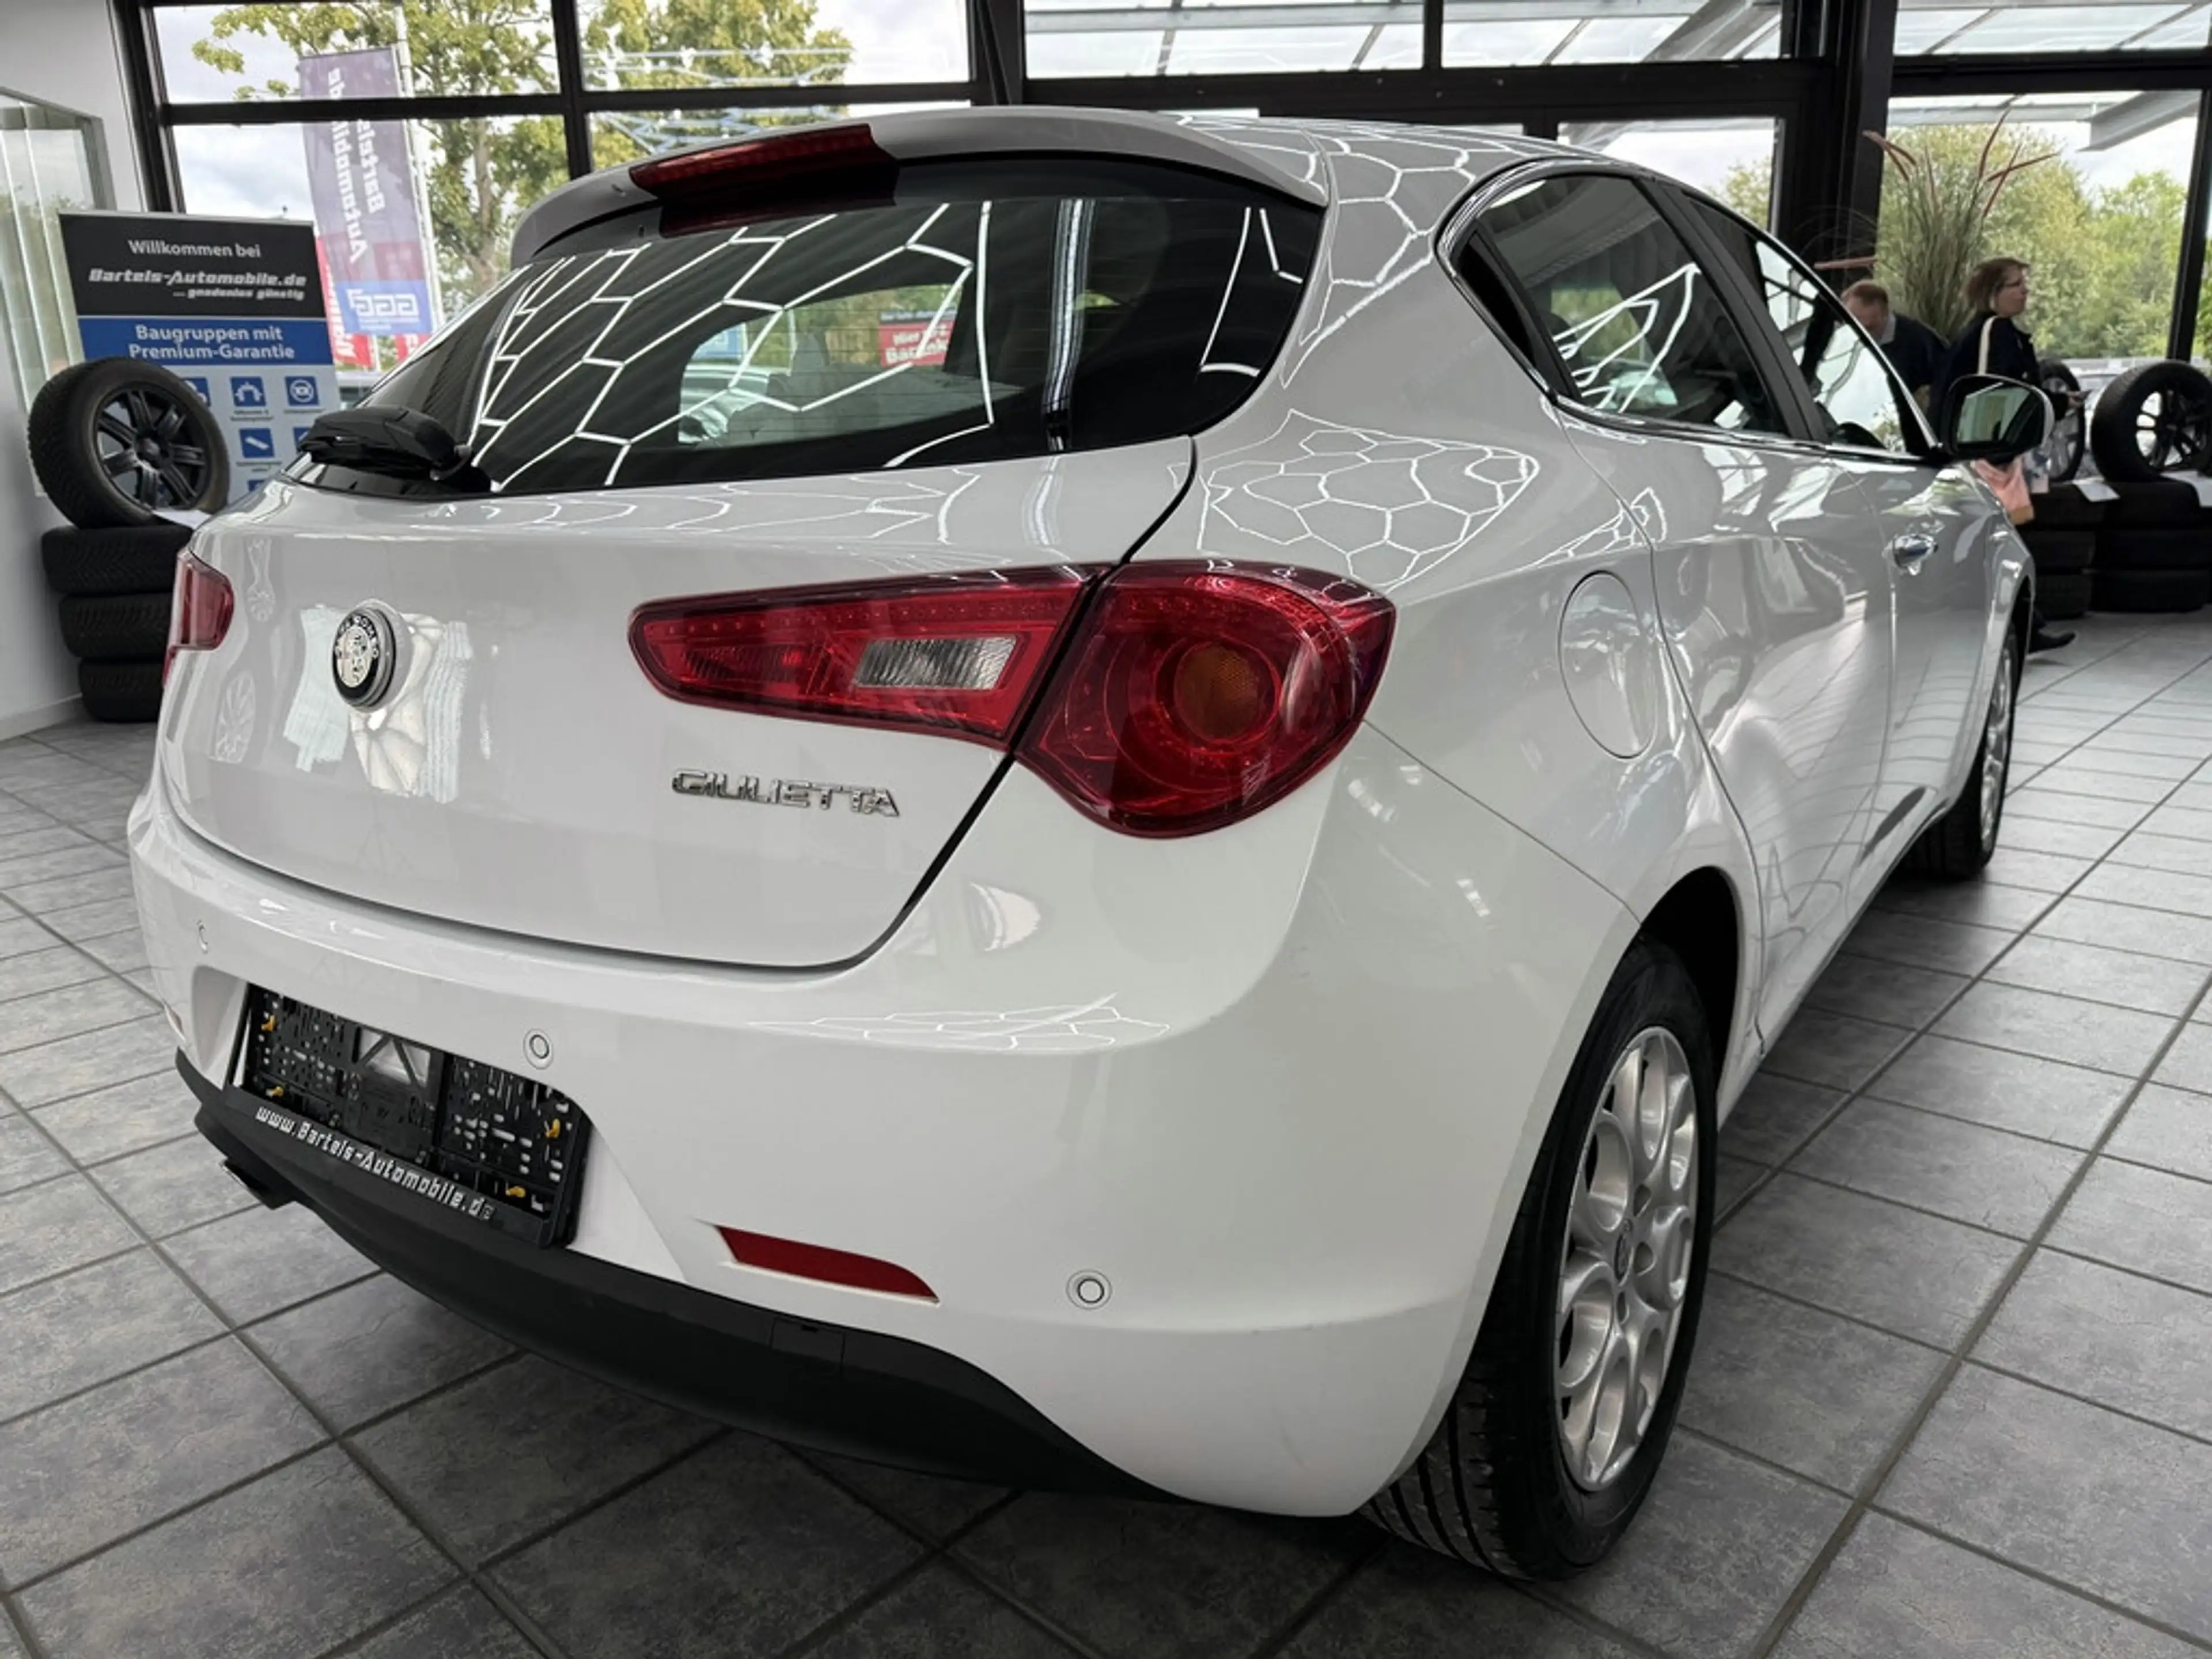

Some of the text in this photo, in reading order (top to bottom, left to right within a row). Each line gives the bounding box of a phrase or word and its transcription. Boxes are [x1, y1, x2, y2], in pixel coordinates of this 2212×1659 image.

[128, 240, 261, 257] Willkommen bei
[89, 268, 306, 286] Bartels-Automobile.de
[135, 323, 283, 343] Baugruppen mit
[128, 343, 295, 359] Premium-Garantie
[672, 768, 900, 817] GIULIETTA
[254, 1105, 497, 1221] www.Bartels-Automobile.de
